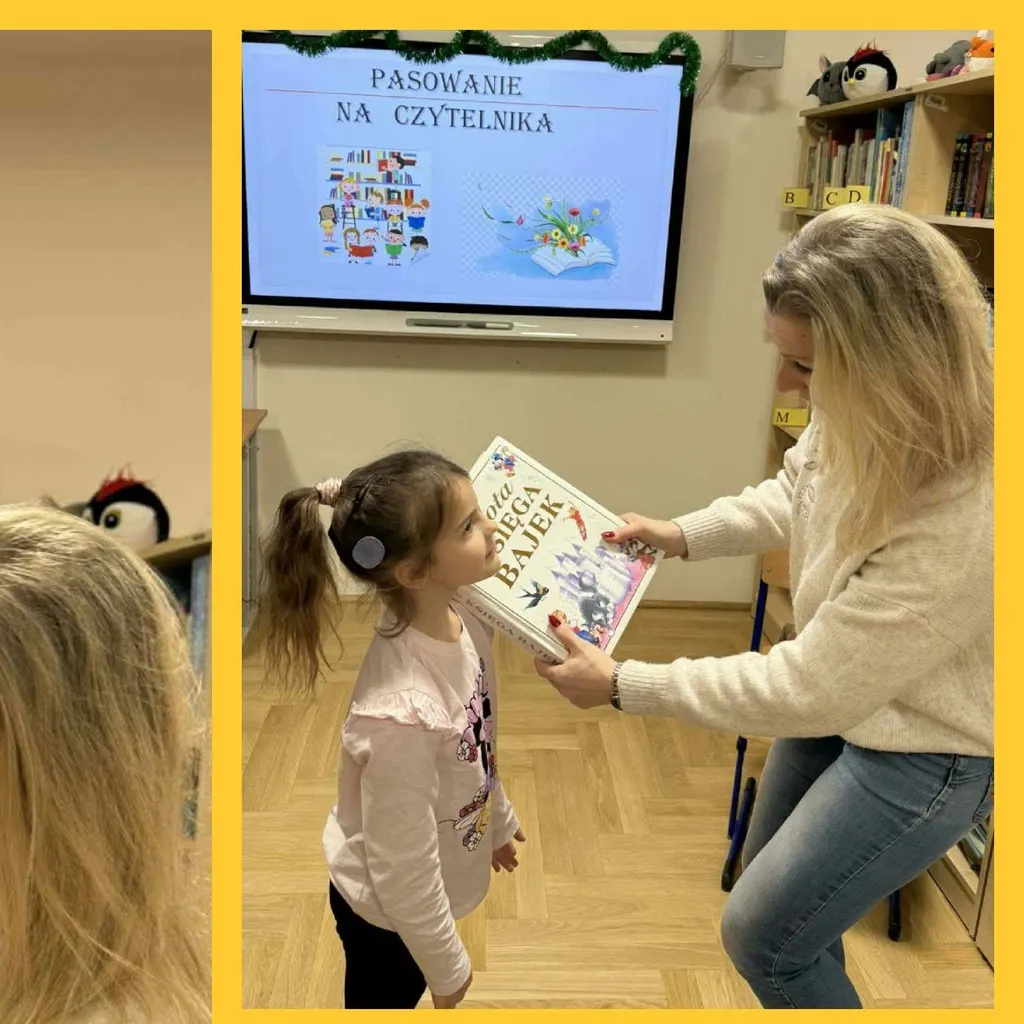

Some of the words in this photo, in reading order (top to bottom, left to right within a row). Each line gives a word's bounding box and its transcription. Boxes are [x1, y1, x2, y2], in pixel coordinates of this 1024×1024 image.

[371, 68, 523, 97] PASOWANIE
[336, 102, 372, 124] NA
[394, 103, 555, 133] CZYTELNIKA
[785, 191, 795, 204] B
[826, 191, 838, 206] C
[849, 190, 861, 203] D
[776, 411, 790, 423] M
[495, 494, 565, 589] BAJEK
